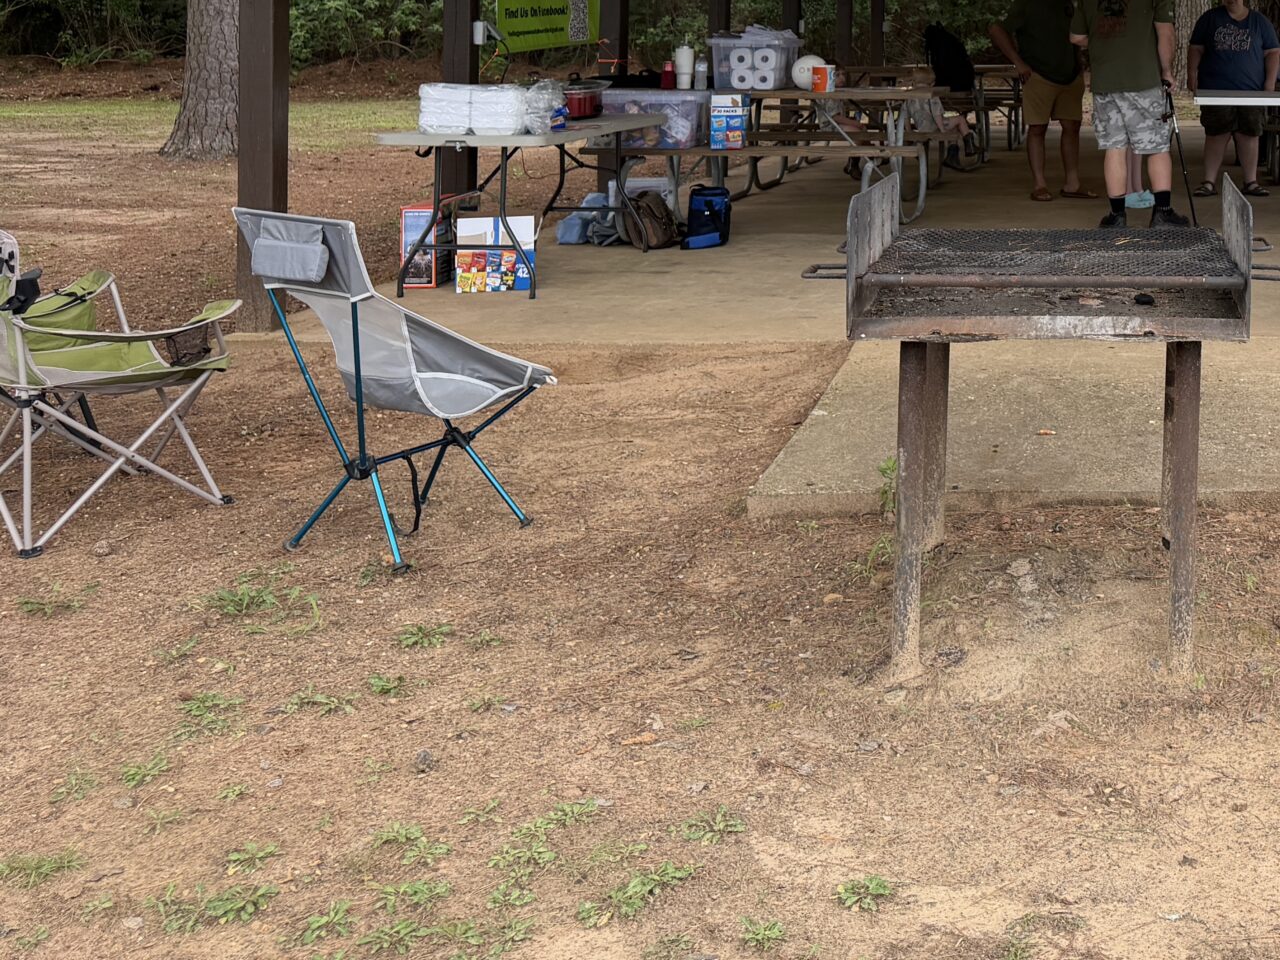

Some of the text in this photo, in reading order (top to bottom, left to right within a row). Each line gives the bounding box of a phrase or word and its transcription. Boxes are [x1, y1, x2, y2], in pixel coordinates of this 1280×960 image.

[504, 7, 519, 19] Find
[520, 6, 529, 18] Us
[530, 5, 538, 17] On
[517, 267, 530, 278] 42
